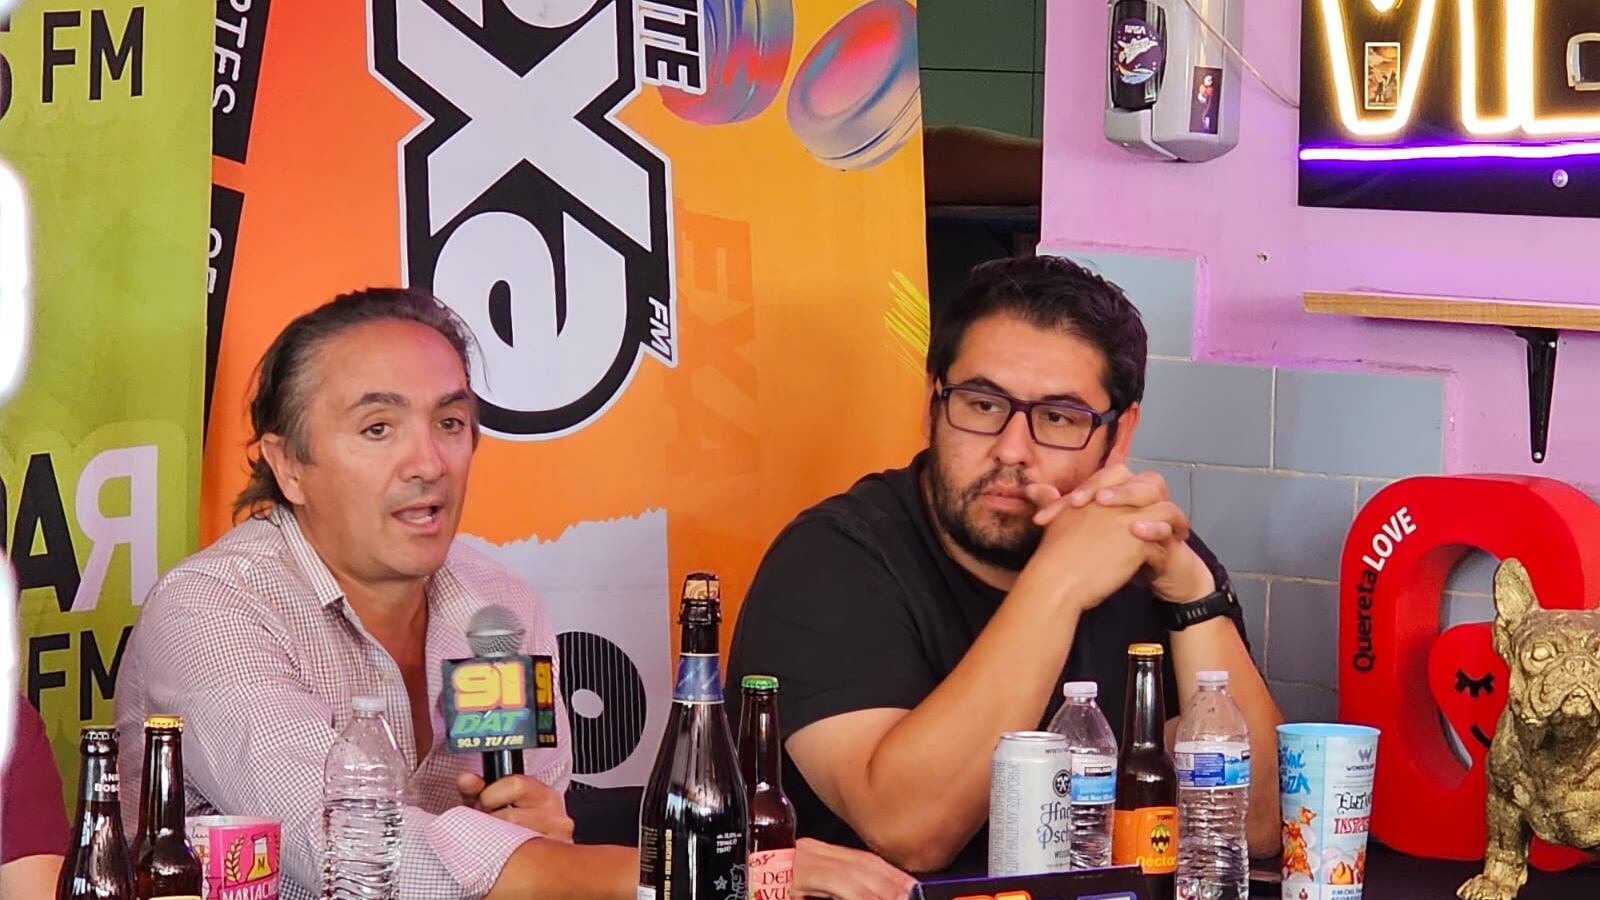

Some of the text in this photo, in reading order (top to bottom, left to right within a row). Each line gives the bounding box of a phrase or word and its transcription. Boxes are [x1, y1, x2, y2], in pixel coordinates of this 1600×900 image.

[41, 7, 145, 103] FM
[642, 0, 702, 89] TE
[1125, 24, 1146, 35] NASA
[397, 0, 653, 412] ex
[648, 296, 673, 360] FM
[27, 625, 134, 720] FM
[451, 661, 527, 712] 91
[450, 709, 531, 739] DAT
[456, 734, 525, 748] 90.9 TU FM
